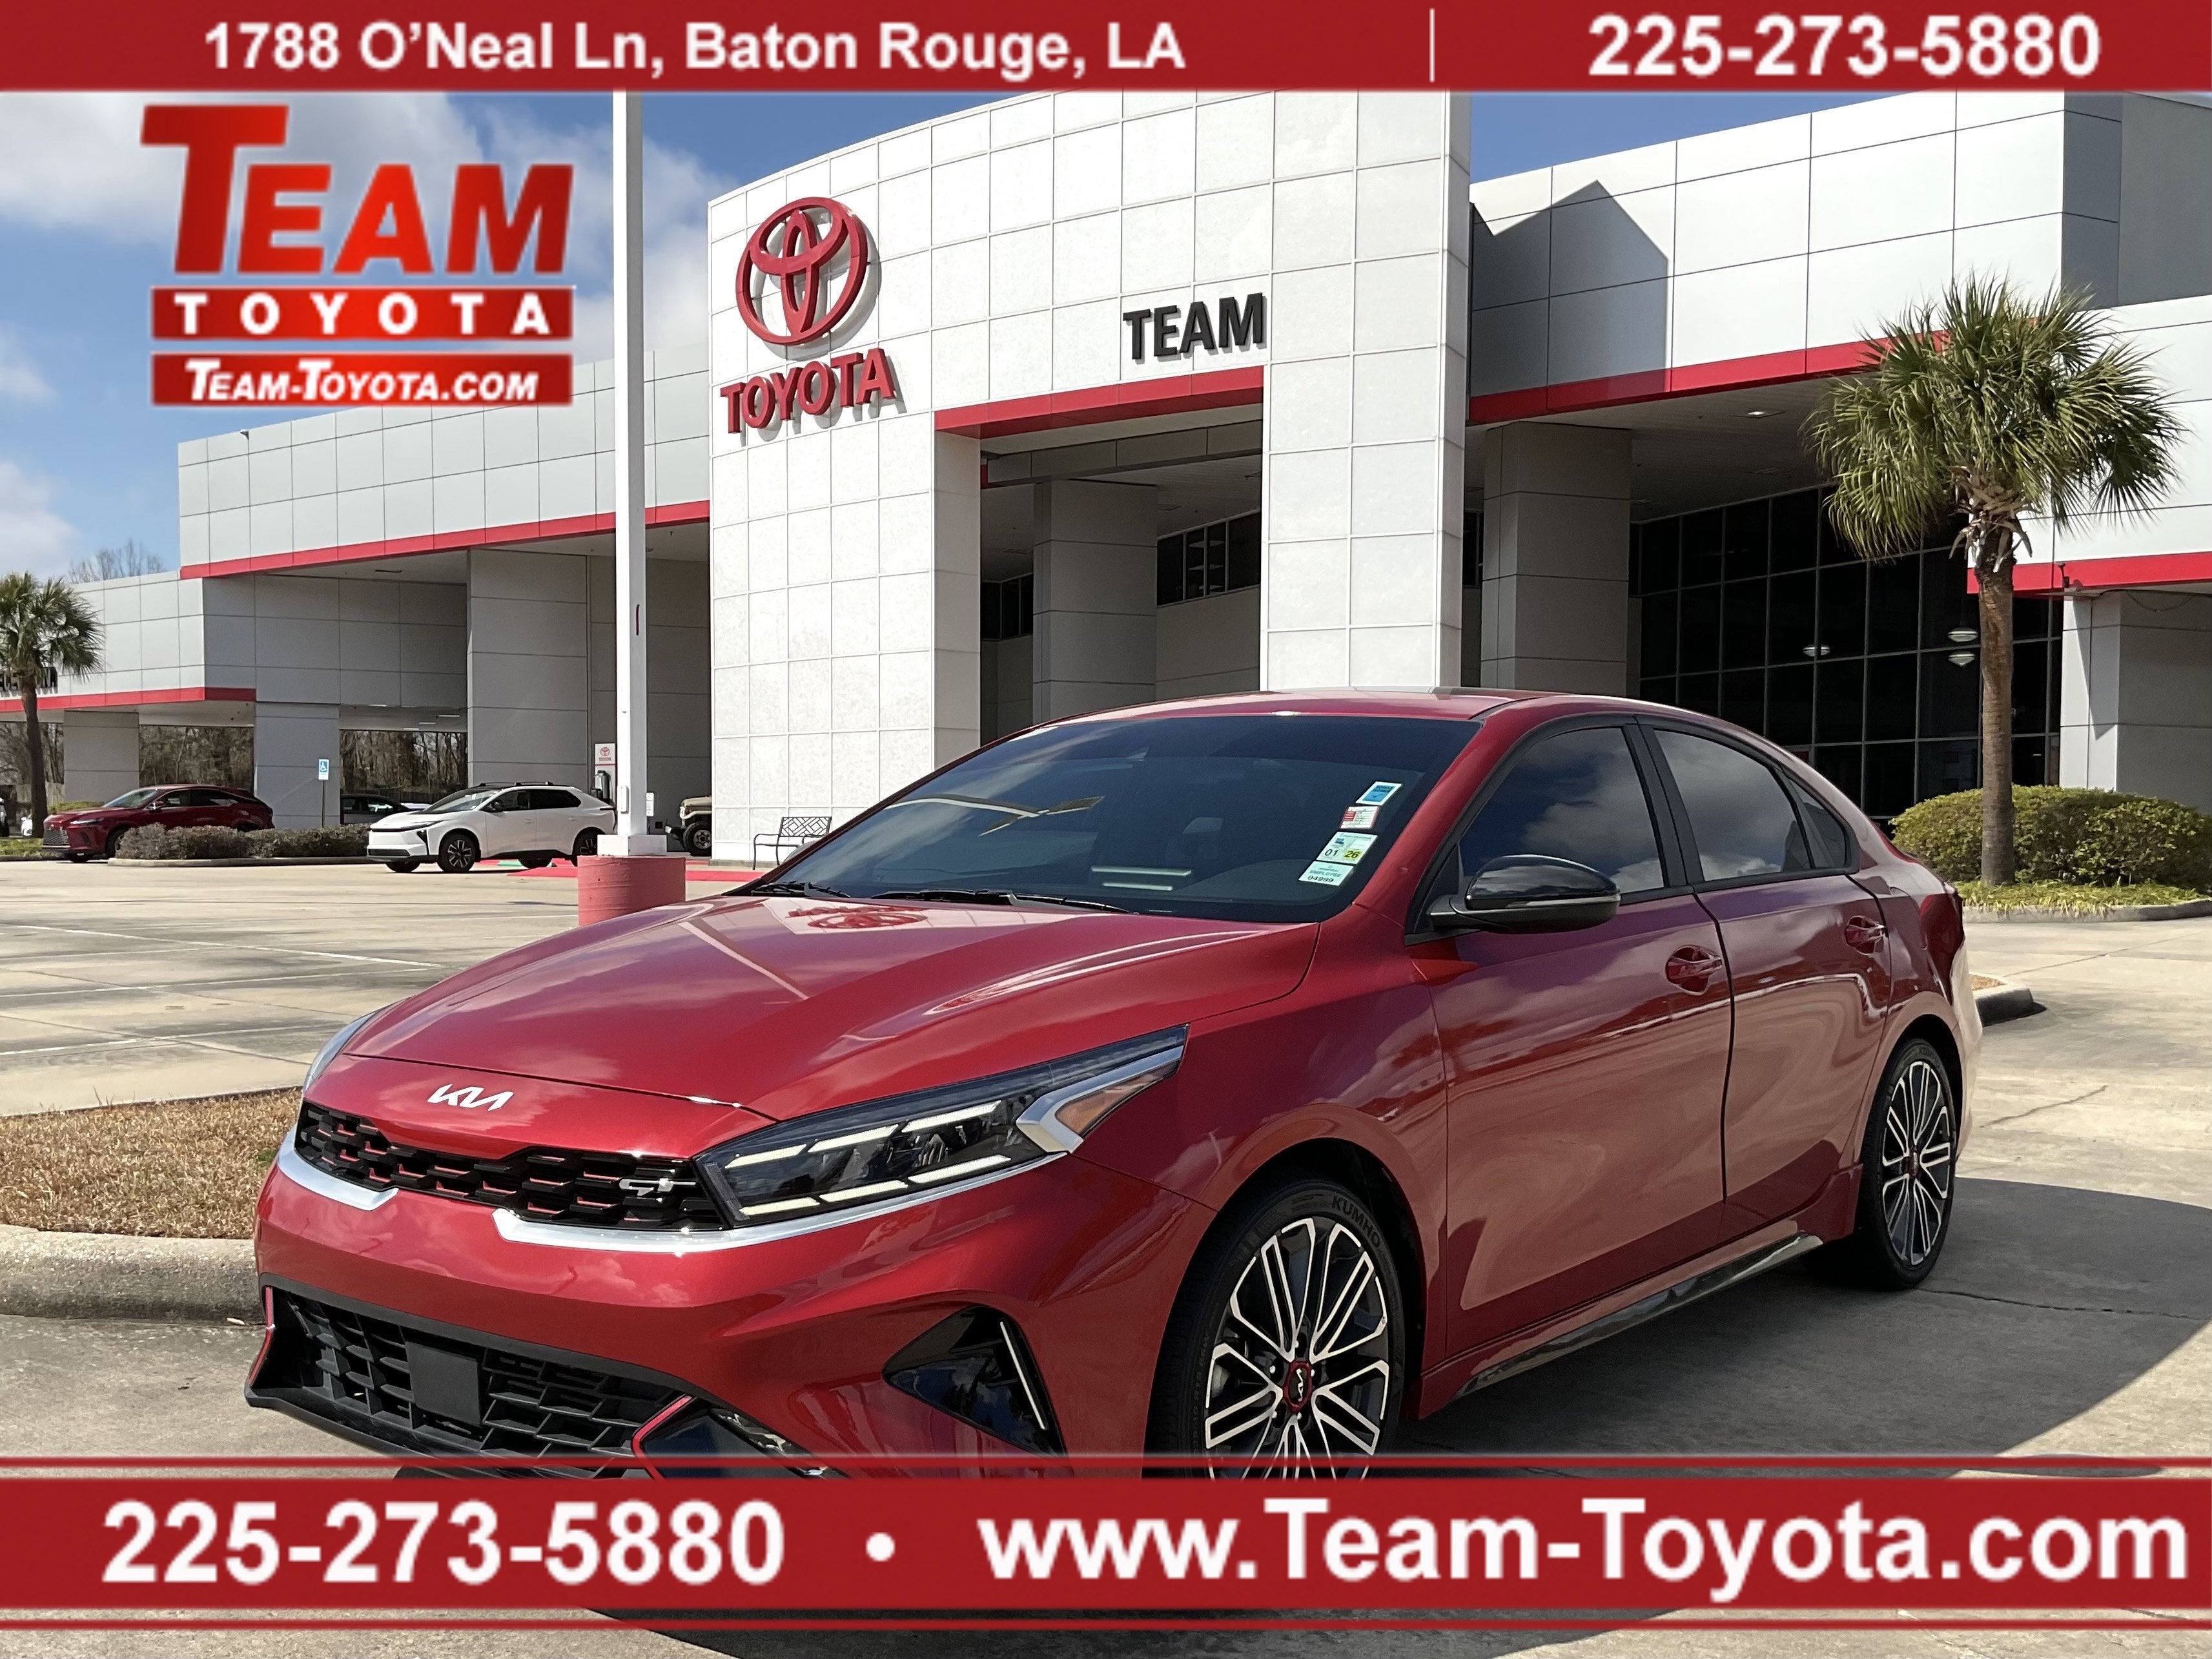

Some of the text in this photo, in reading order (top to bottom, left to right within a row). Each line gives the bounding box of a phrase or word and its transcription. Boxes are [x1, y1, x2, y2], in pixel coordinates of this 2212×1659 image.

[1122, 292, 1265, 362] TEAM
[719, 346, 897, 435] TOYOTA
[1344, 850, 1360, 858] 26
[427, 1083, 515, 1112] KIA
[1331, 1193, 1382, 1249] KUMHO
